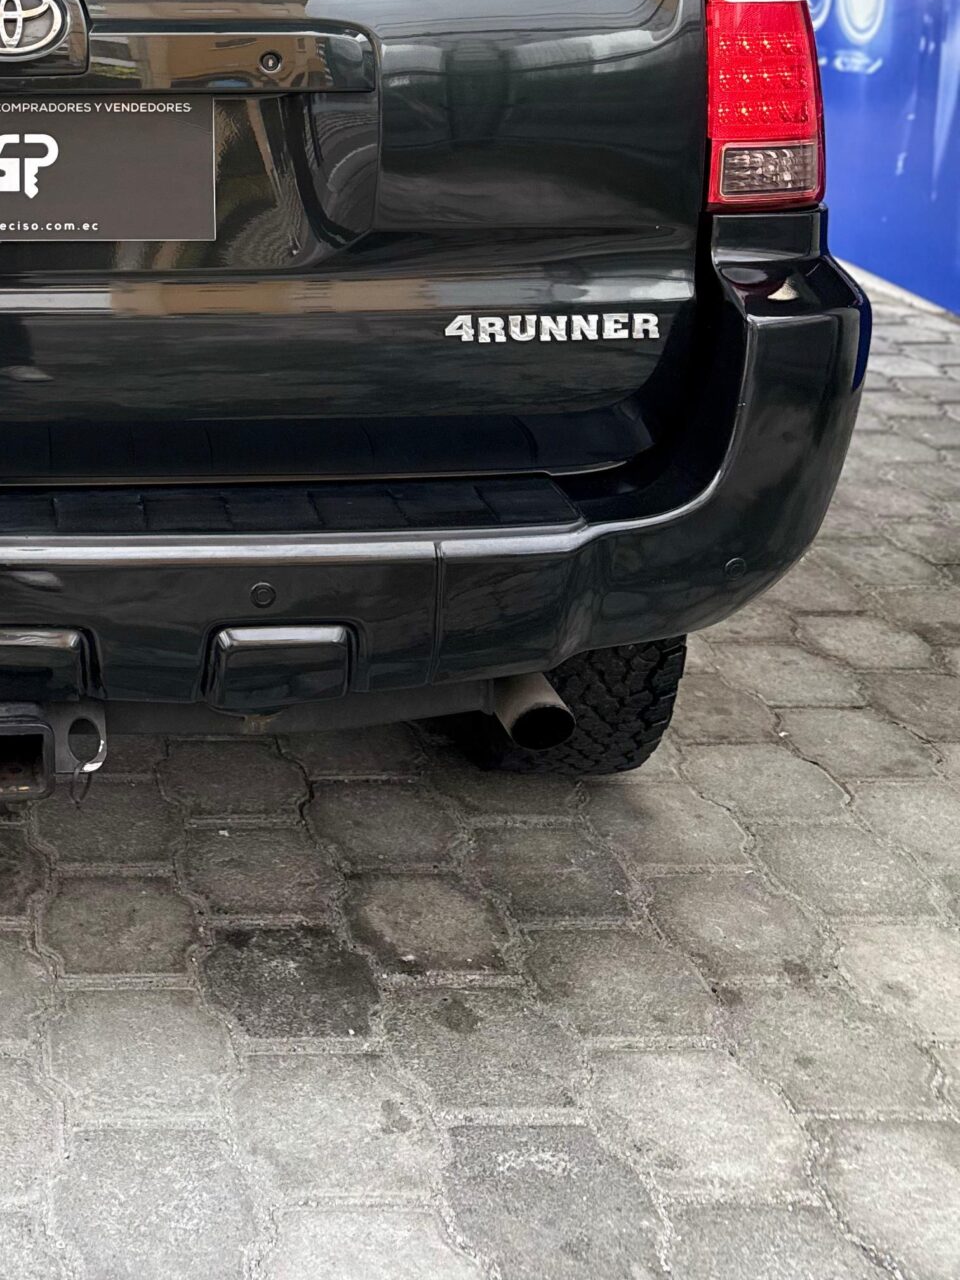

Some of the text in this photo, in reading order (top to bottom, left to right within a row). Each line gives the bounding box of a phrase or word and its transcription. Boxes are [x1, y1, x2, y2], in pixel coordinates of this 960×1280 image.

[94, 102, 103, 112] Y
[104, 102, 192, 112] VENDEDORES
[444, 313, 660, 343] 4RUNNER
